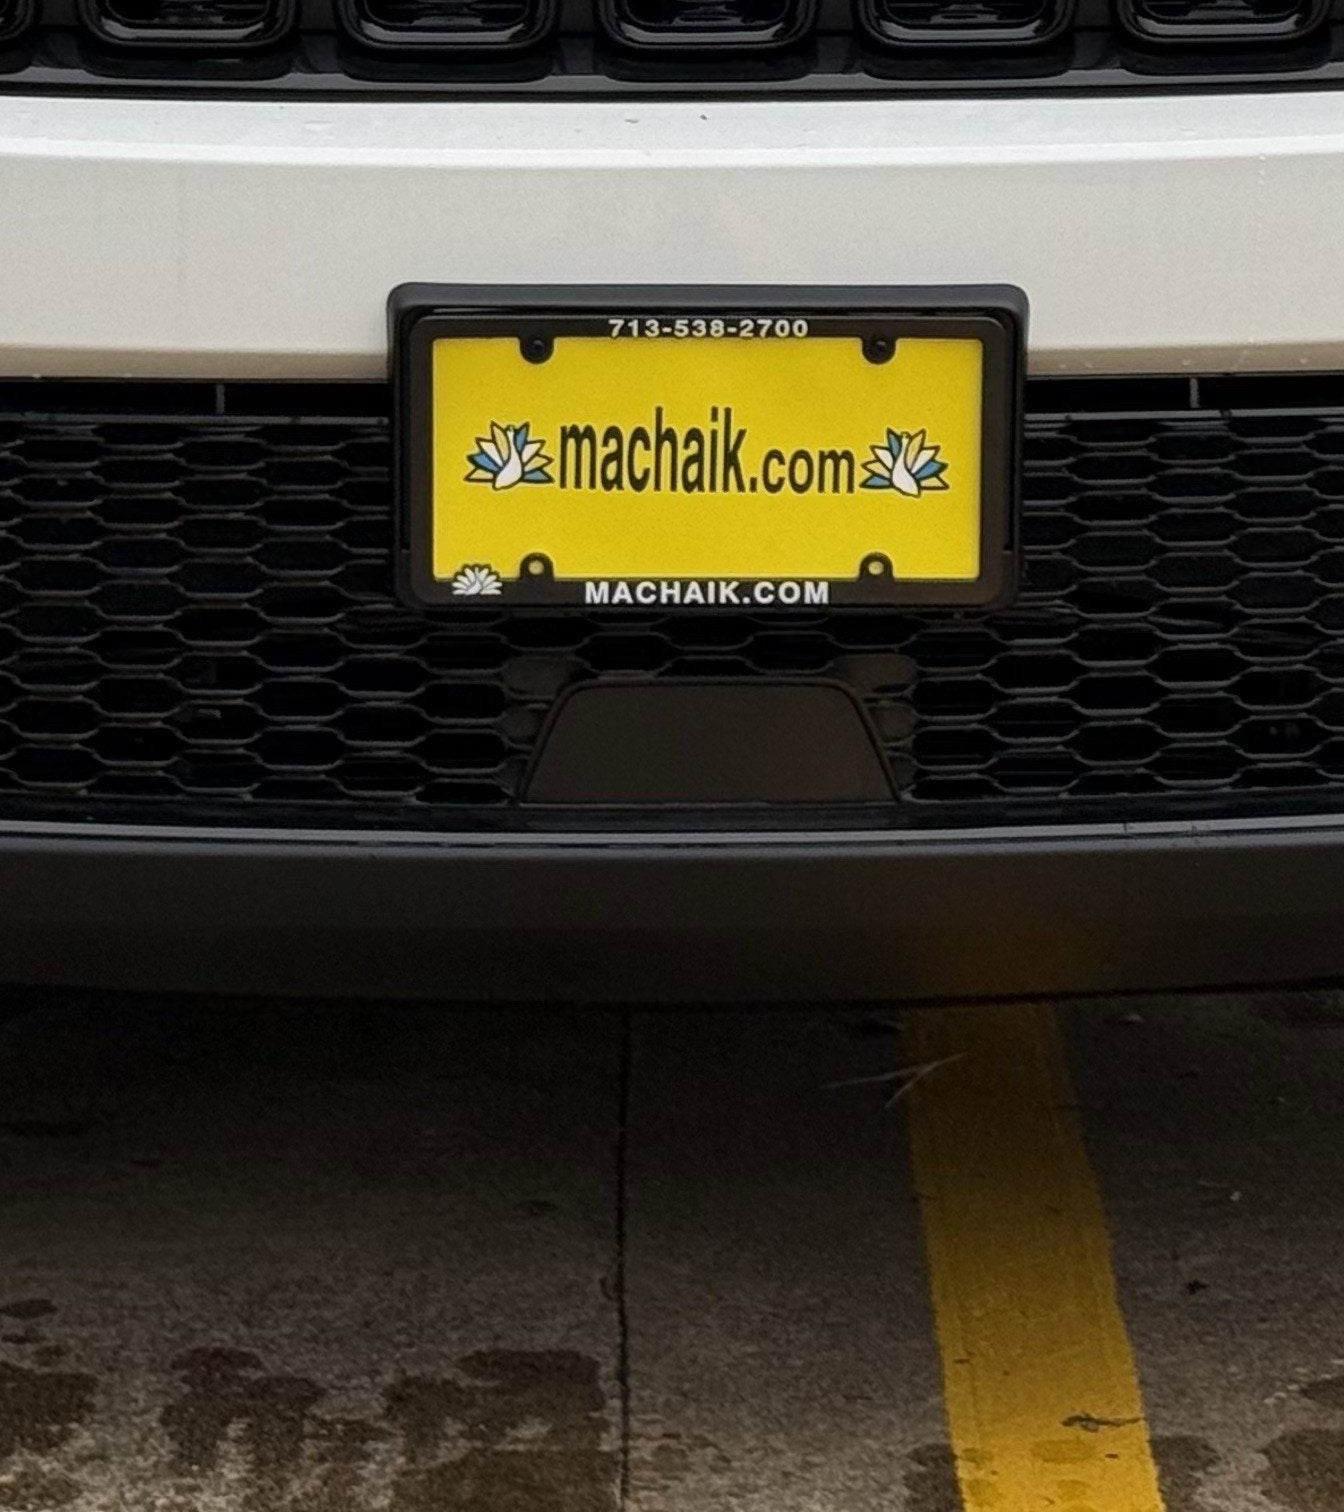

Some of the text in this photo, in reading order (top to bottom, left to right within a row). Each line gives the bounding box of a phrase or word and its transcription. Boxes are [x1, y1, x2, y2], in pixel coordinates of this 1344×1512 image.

[608, 318, 808, 338] 713-538-2700
[559, 406, 856, 494] machaik.com
[585, 580, 829, 605] MACHAIK.COM
